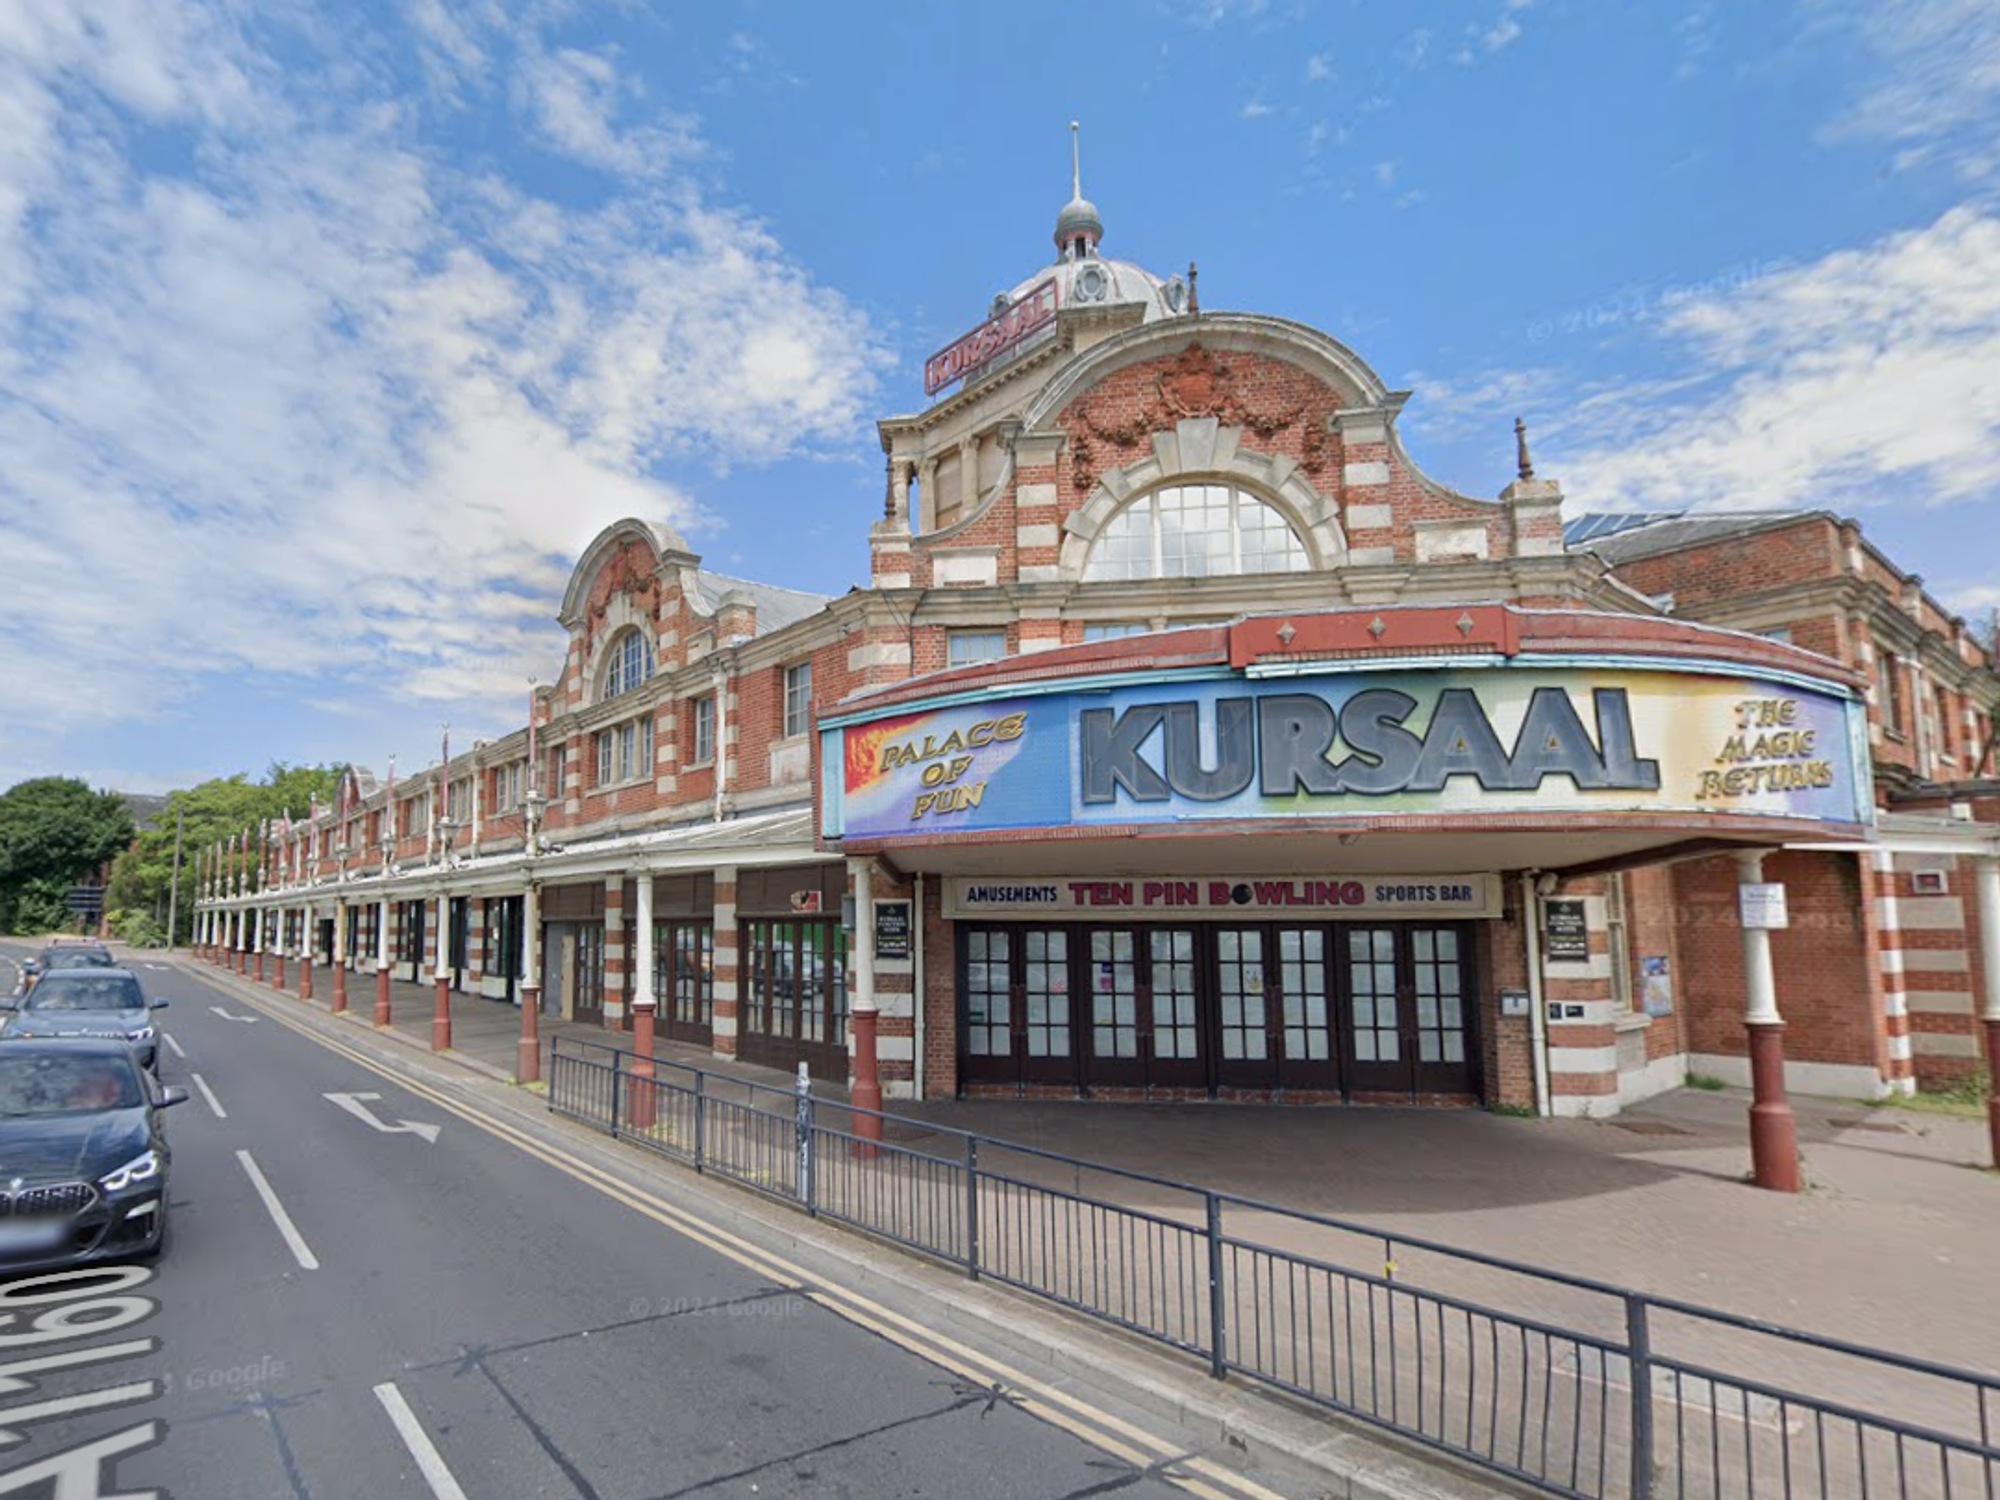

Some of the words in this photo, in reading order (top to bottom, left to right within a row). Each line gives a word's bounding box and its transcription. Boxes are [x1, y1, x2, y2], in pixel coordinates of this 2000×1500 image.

[931, 294, 1052, 386] KURSAAL
[1735, 700, 1797, 729] THE
[880, 712, 1028, 772] PALACE
[1080, 687, 1661, 804] KURSAAL
[1714, 730, 1816, 764] MAGIC
[920, 754, 975, 789] OF
[1694, 761, 1834, 801] RETURNS
[911, 780, 987, 820] FUN
[967, 886, 1057, 903] AMUSEMENTS
[1069, 882, 1134, 906] TEN
[1143, 882, 1200, 905] PIN
[1209, 882, 1366, 906] BOWLING
[1375, 885, 1436, 902] SPORTS
[1440, 885, 1472, 902] BAR
